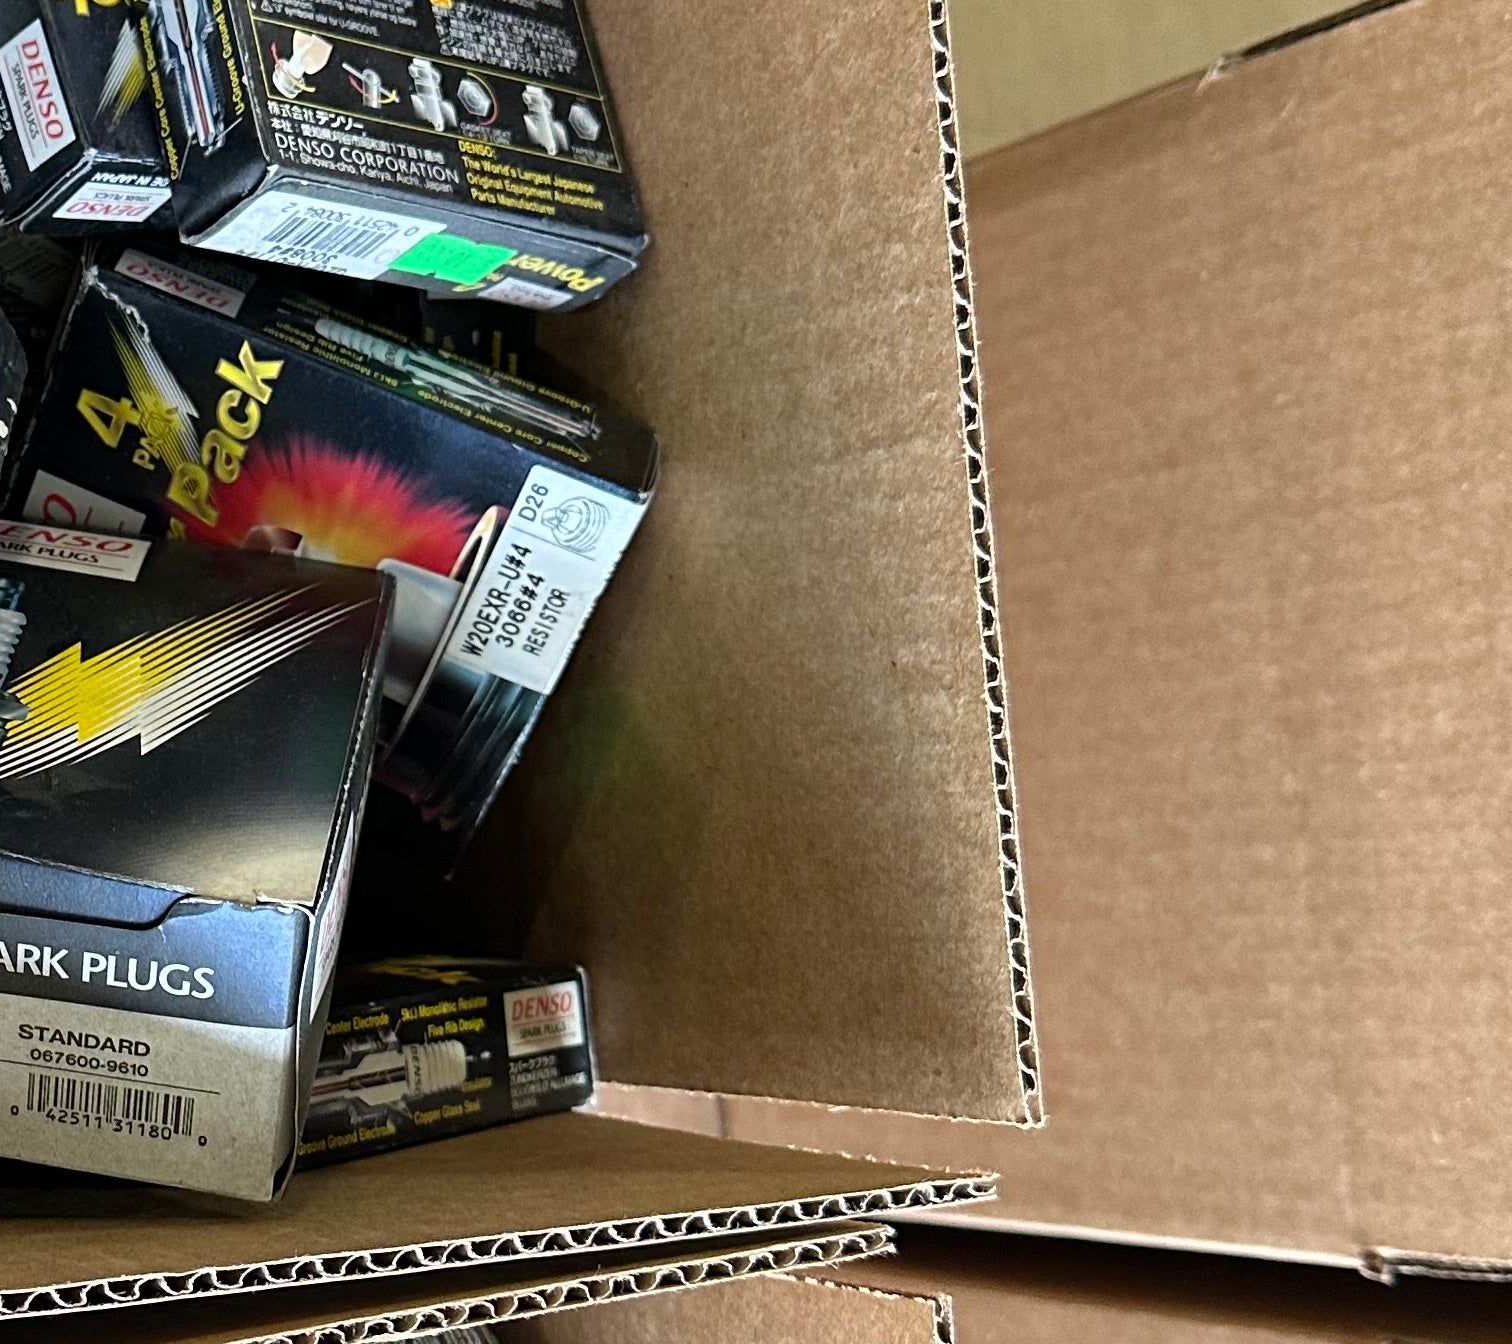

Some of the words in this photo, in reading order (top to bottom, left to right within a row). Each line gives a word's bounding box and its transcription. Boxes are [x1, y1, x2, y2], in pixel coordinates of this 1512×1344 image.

[214, 15, 235, 57] Ground
[21, 39, 65, 139] DENSO
[223, 57, 248, 113] U-Groove
[275, 134, 335, 160] DENSO
[340, 145, 460, 184] CORPORATION
[166, 340, 286, 528] Pack
[517, 482, 551, 523] D26
[38, 547, 99, 563] PLUGS
[460, 541, 533, 658] W20EXR-U#4
[495, 574, 547, 646] 3066#4
[522, 590, 570, 656] RESISTOR
[83, 952, 215, 1001] PLUGS
[511, 990, 572, 1022] DENSO
[18, 1024, 151, 1058] STANDARD
[30, 1047, 149, 1078] 067600-9610
[10, 1105, 20, 1116] 0
[46, 1107, 104, 1130] 42511
[112, 1117, 173, 1142] 31180
[198, 1135, 208, 1147] 0
